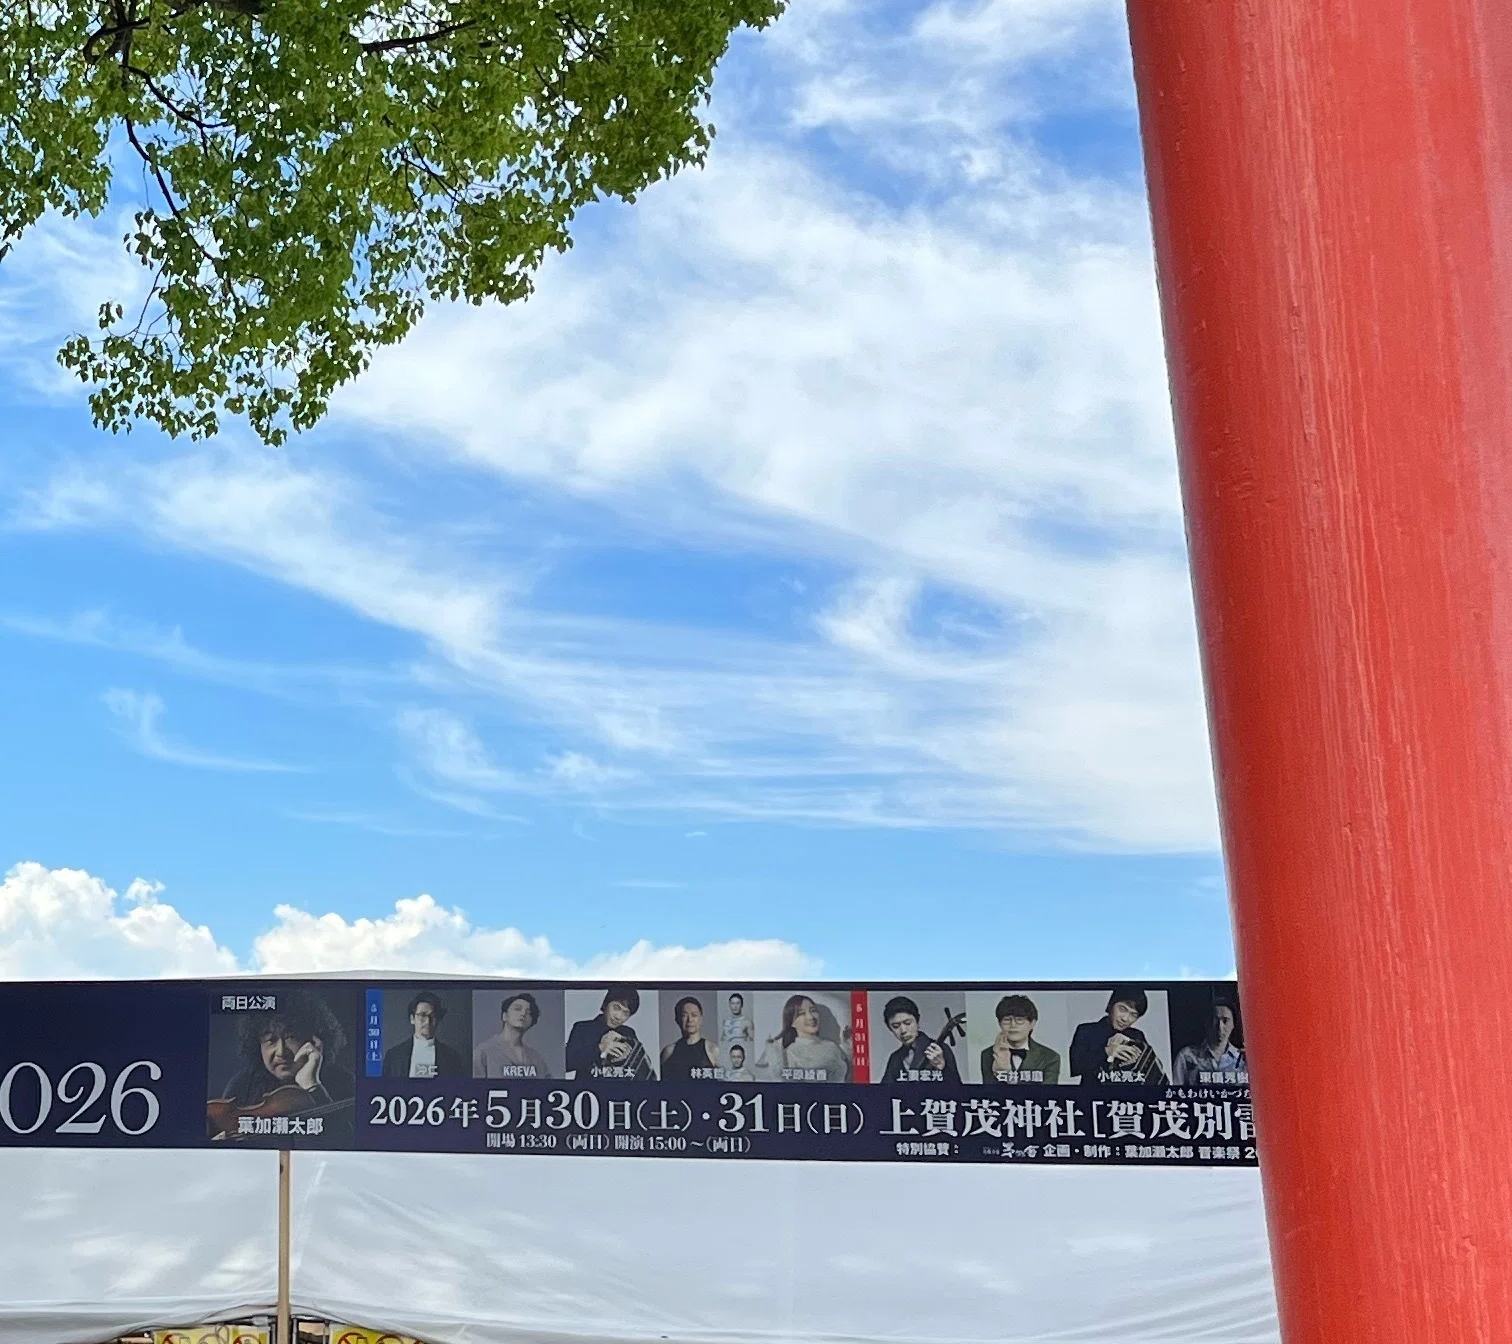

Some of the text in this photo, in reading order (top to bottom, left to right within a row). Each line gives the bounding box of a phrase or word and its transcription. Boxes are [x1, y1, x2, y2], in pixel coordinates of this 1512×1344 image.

[221, 995, 277, 1011] 両日公演
[503, 1064, 537, 1078] KREVA
[590, 1066, 635, 1079] 小松亮太
[1097, 1067, 1146, 1084] 小松亮太
[237, 1116, 324, 1135] 葉加瀬太郎
[519, 1134, 557, 1149] 13:30
[649, 1136, 687, 1151] 15:00
[1244, 1146, 1256, 1160] 2
